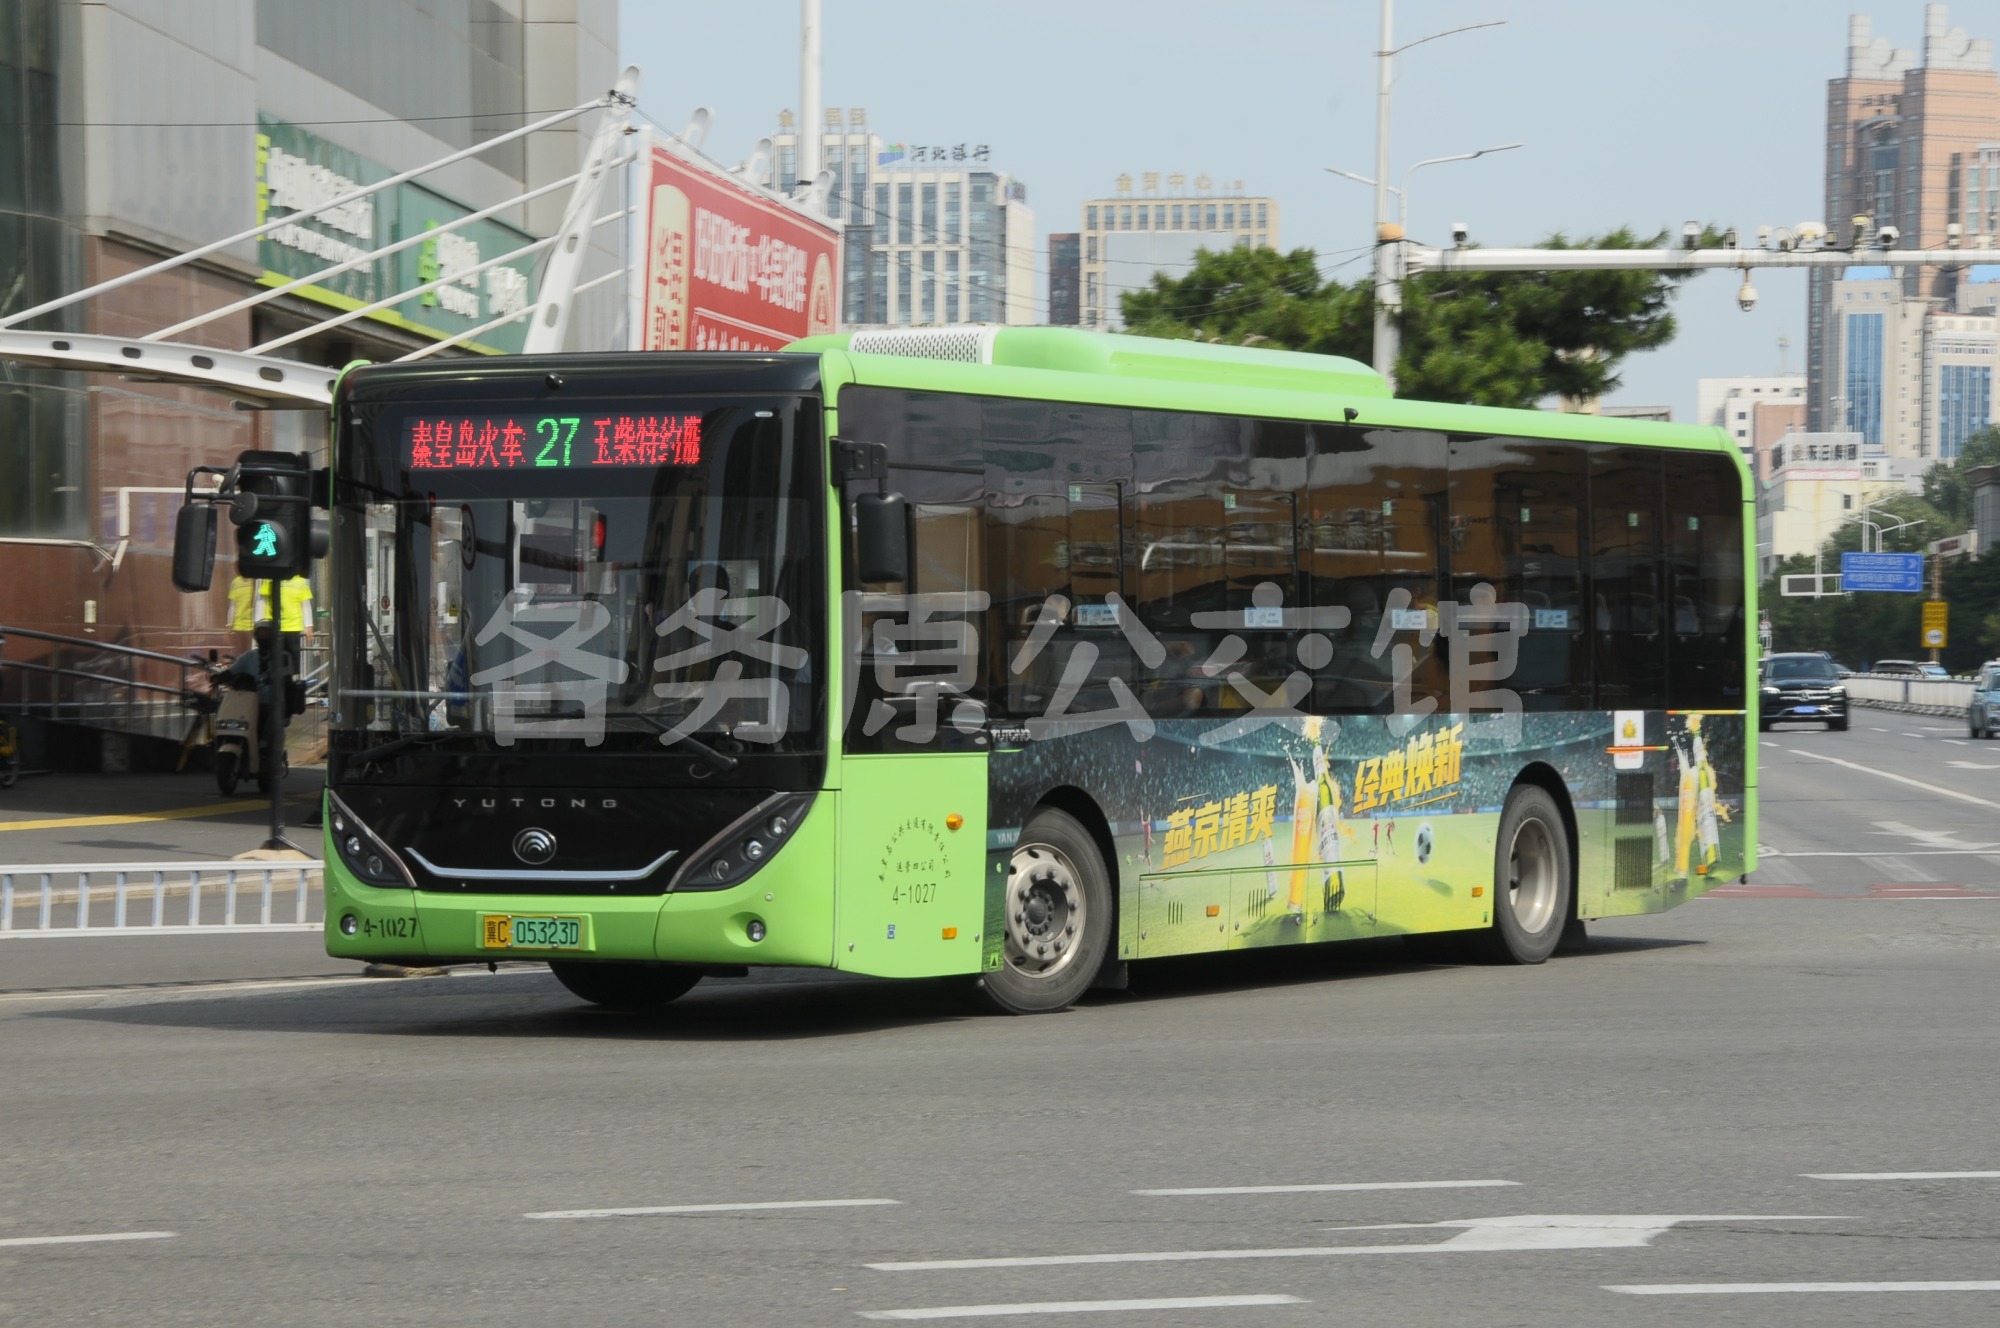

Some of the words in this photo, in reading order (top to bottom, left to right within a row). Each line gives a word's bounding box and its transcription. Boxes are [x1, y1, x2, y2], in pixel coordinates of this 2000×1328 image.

[535, 418, 580, 467] 27
[1353, 721, 1464, 814] 经典焕新
[453, 798, 617, 808] YUTONG
[1159, 783, 1277, 871] 燕京清爽
[892, 883, 937, 904] 4-1027
[363, 917, 417, 938] 4-1027
